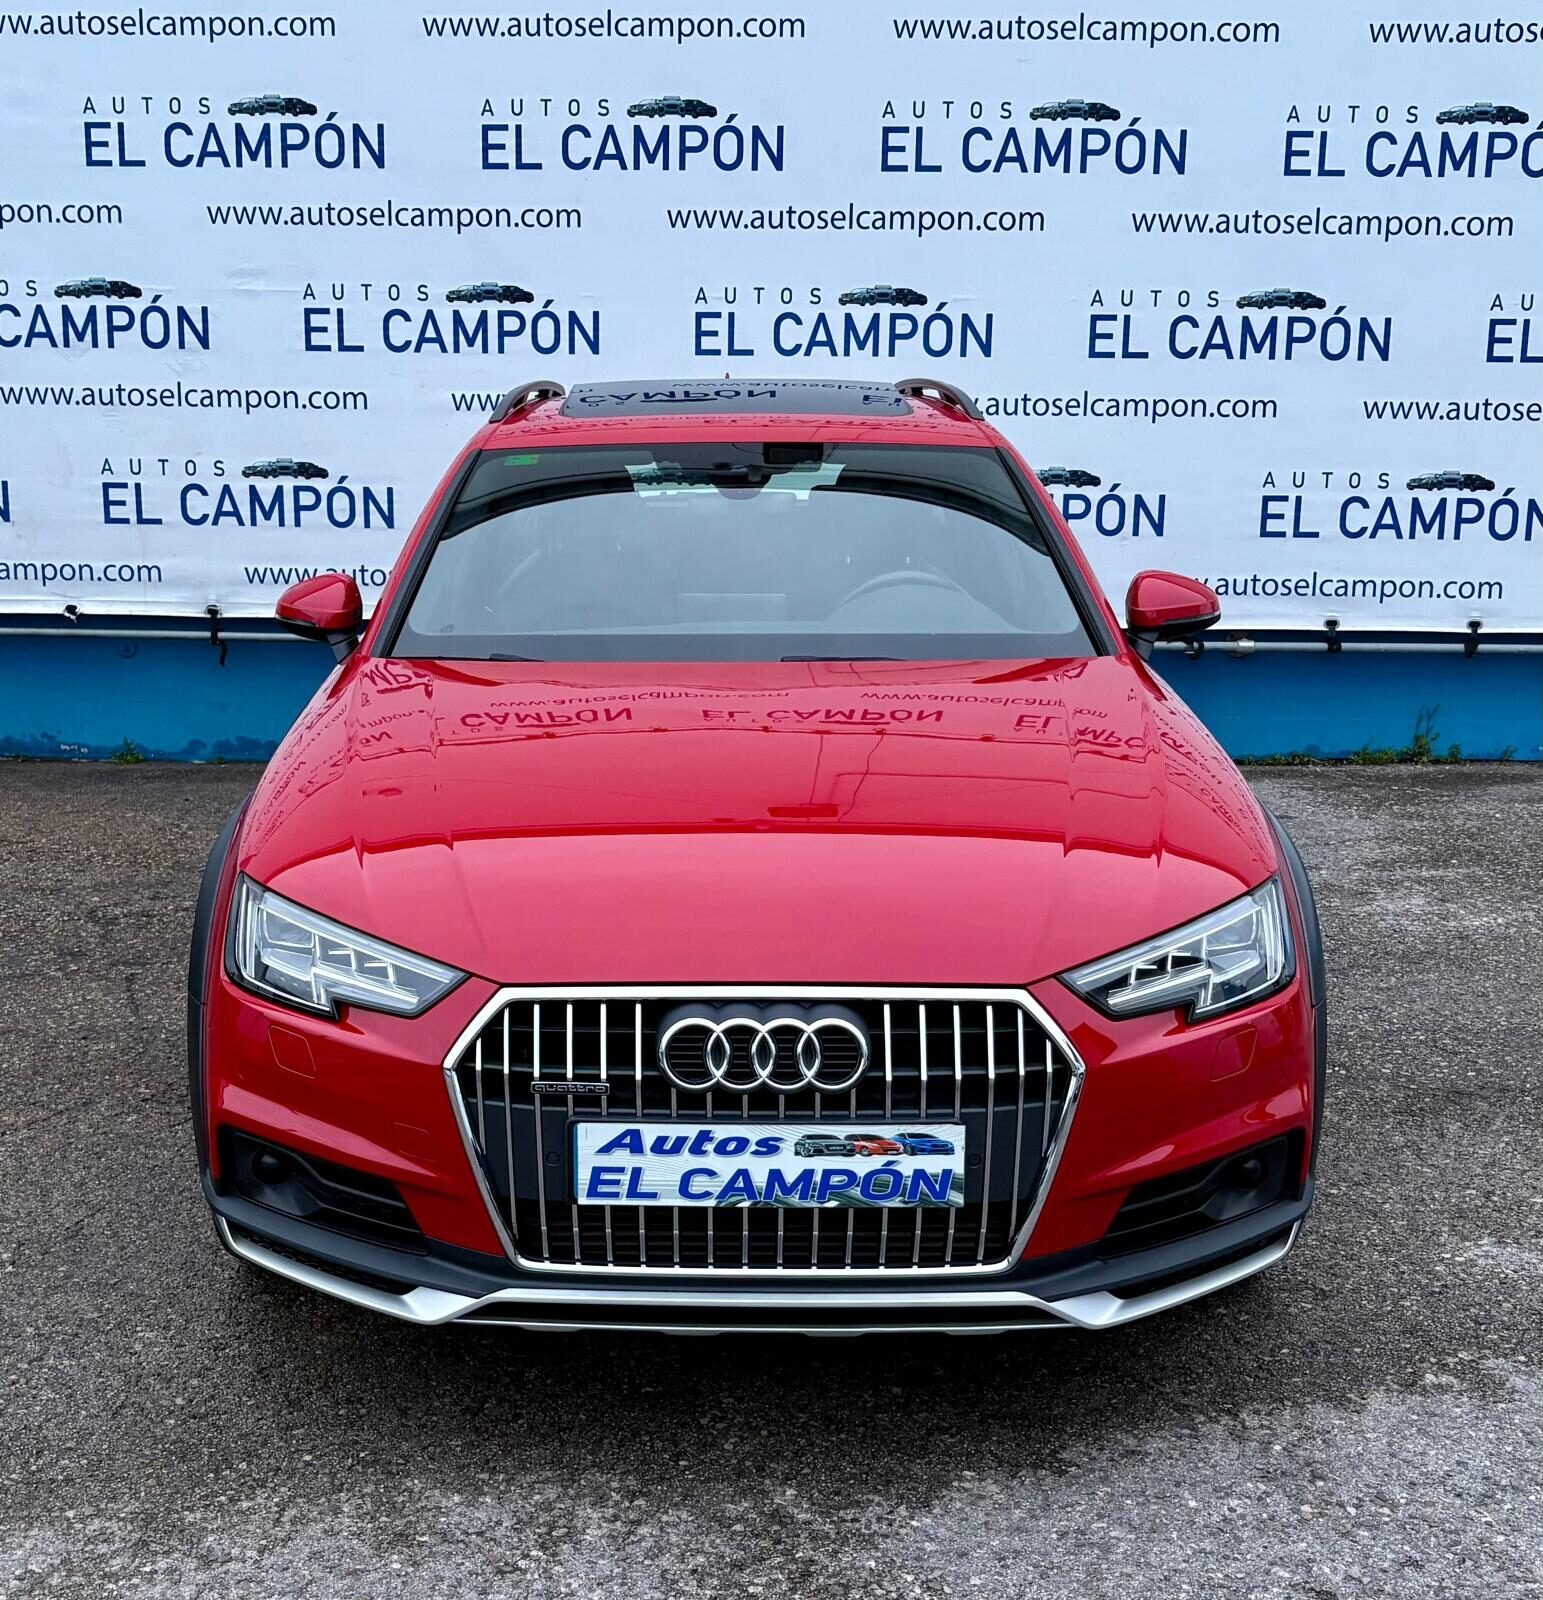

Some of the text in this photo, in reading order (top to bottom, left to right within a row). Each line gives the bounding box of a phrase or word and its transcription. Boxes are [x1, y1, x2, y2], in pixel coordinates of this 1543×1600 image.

[0, 8, 336, 44] w.autoselcampon.com
[422, 9, 805, 45] www.autoselcampon.com
[892, 13, 1280, 49] www.autoselcampon.com
[1369, 18, 1543, 43] www.autos
[83, 96, 211, 115] AUTOS
[481, 98, 610, 117] AUTOS
[881, 101, 1012, 119] AUTOS
[1286, 105, 1419, 123] AUTOS
[83, 112, 386, 170] EL CAMPÓN
[481, 113, 785, 171] EL CAMPÓN
[880, 117, 1188, 175] EL CAMPÓN
[1283, 130, 1346, 177] EL
[206, 200, 582, 235] www.autoselcampon.com
[666, 203, 1045, 238] www.autoselcampon.com
[1131, 207, 1514, 243] www.autoselcampon.com
[302, 283, 429, 301] AUTOS
[694, 286, 822, 305] AUTOS
[1090, 290, 1220, 308] AUTOS
[0, 294, 211, 351] CAMPÓN
[303, 299, 600, 355] EL CAMPÓN
[694, 302, 994, 358] EL CAMPÓN
[1087, 305, 1392, 362] EL CAMPÓN
[1485, 319, 1543, 363] EL
[0, 381, 368, 415] www.autoselcampon.com
[451, 393, 507, 412] ww
[974, 387, 1278, 425] autoselcampon.com
[100, 457, 225, 477] AUTOS
[1262, 472, 1390, 490] AUTOS
[101, 475, 395, 530] EL CAMPÓN
[1050, 483, 1167, 537] PÓN
[1259, 494, 1320, 539] EL
[1195, 571, 1503, 604] autoselcampon.com
[534, 1084, 606, 1093] quattro
[594, 1128, 785, 1156] Autos
[586, 1160, 954, 1202] EL CAMPÓN
